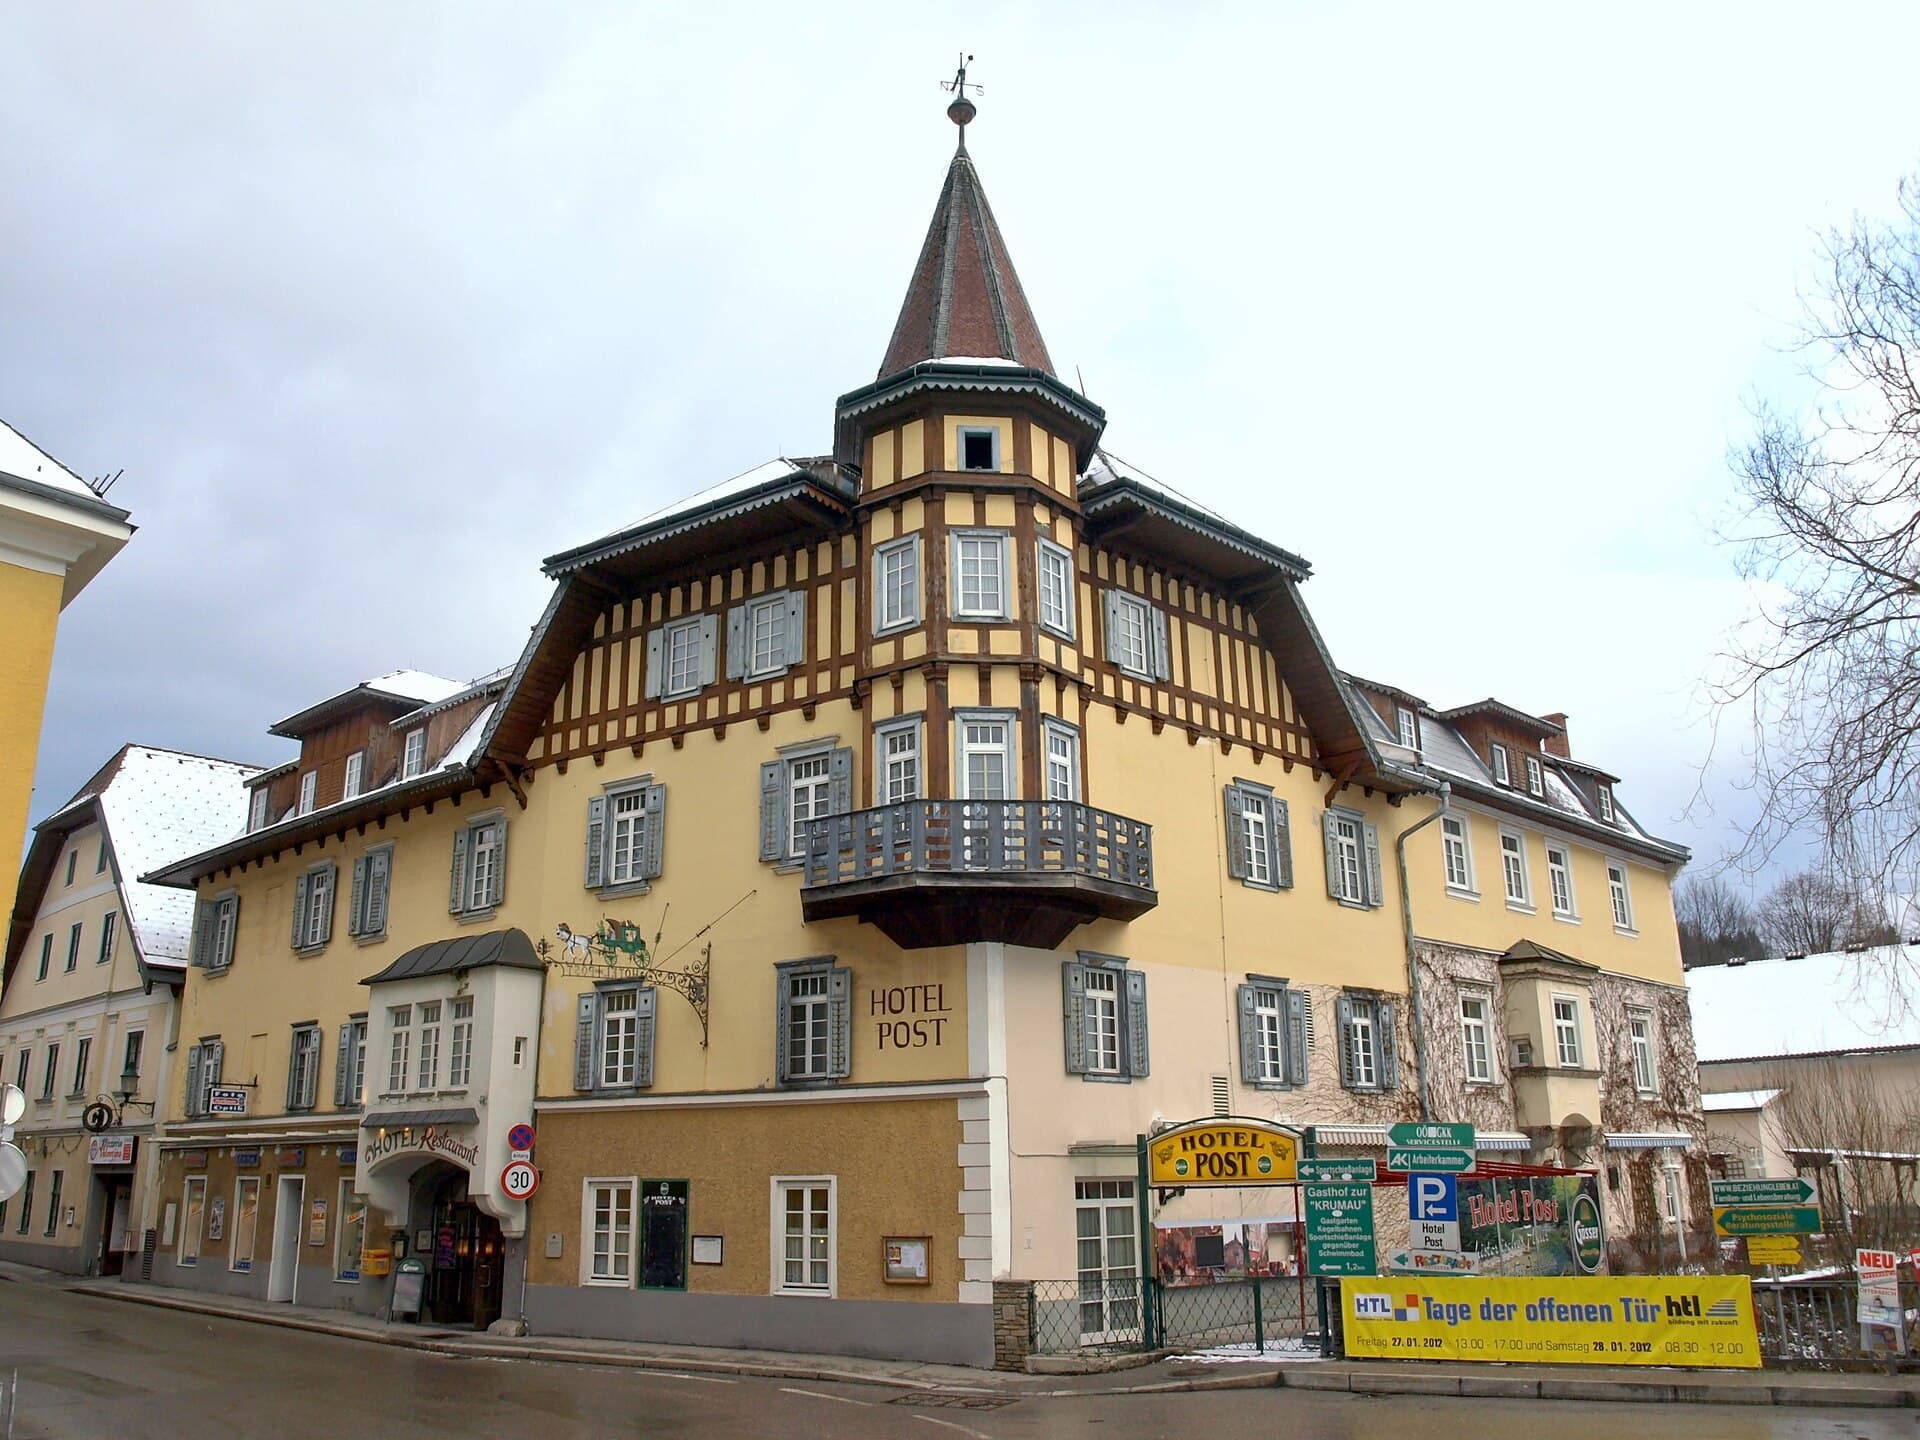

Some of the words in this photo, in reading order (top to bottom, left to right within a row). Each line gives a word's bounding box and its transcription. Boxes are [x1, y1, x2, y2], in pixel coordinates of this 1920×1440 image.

[871, 984, 952, 1016] HOTEL
[876, 1018, 947, 1049] POST
[372, 1129, 418, 1160] HOTEL
[1180, 1132, 1265, 1152] HOTEL
[1195, 1152, 1251, 1177] POST
[1391, 1153, 1408, 1166] AK
[1412, 1154, 1464, 1165] Arbeiterkammer
[511, 1171, 529, 1188] 30
[1307, 1186, 1348, 1197] Gasthof
[1351, 1188, 1367, 1197] zur
[1310, 1200, 1366, 1210] "KRUMAU"
[1467, 1189, 1520, 1229] Hotel
[1521, 1189, 1559, 1222] Post
[1732, 1213, 1794, 1223] Psychosoziale
[1422, 1223, 1445, 1233] Hotel
[1309, 1234, 1372, 1242] Sportschießanlage
[1322, 1242, 1359, 1250] gegenüber
[1425, 1236, 1443, 1247] Post
[1859, 1252, 1894, 1268] NEU
[1356, 1297, 1391, 1312] HTL
[1422, 1297, 1471, 1325] Tage
[1480, 1297, 1517, 1321] der
[1525, 1297, 1612, 1322] offenen
[1620, 1297, 1661, 1323] Tür
[1665, 1295, 1701, 1316] htl
[1357, 1336, 1387, 1347] Freitag
[1455, 1338, 1484, 1349] 13.00
[1494, 1339, 1523, 1350] 17.00
[1526, 1341, 1543, 1351] und
[1546, 1341, 1589, 1353] Samstag
[1665, 1342, 1699, 1353] 08.30
[1711, 1343, 1744, 1354] 12.00
